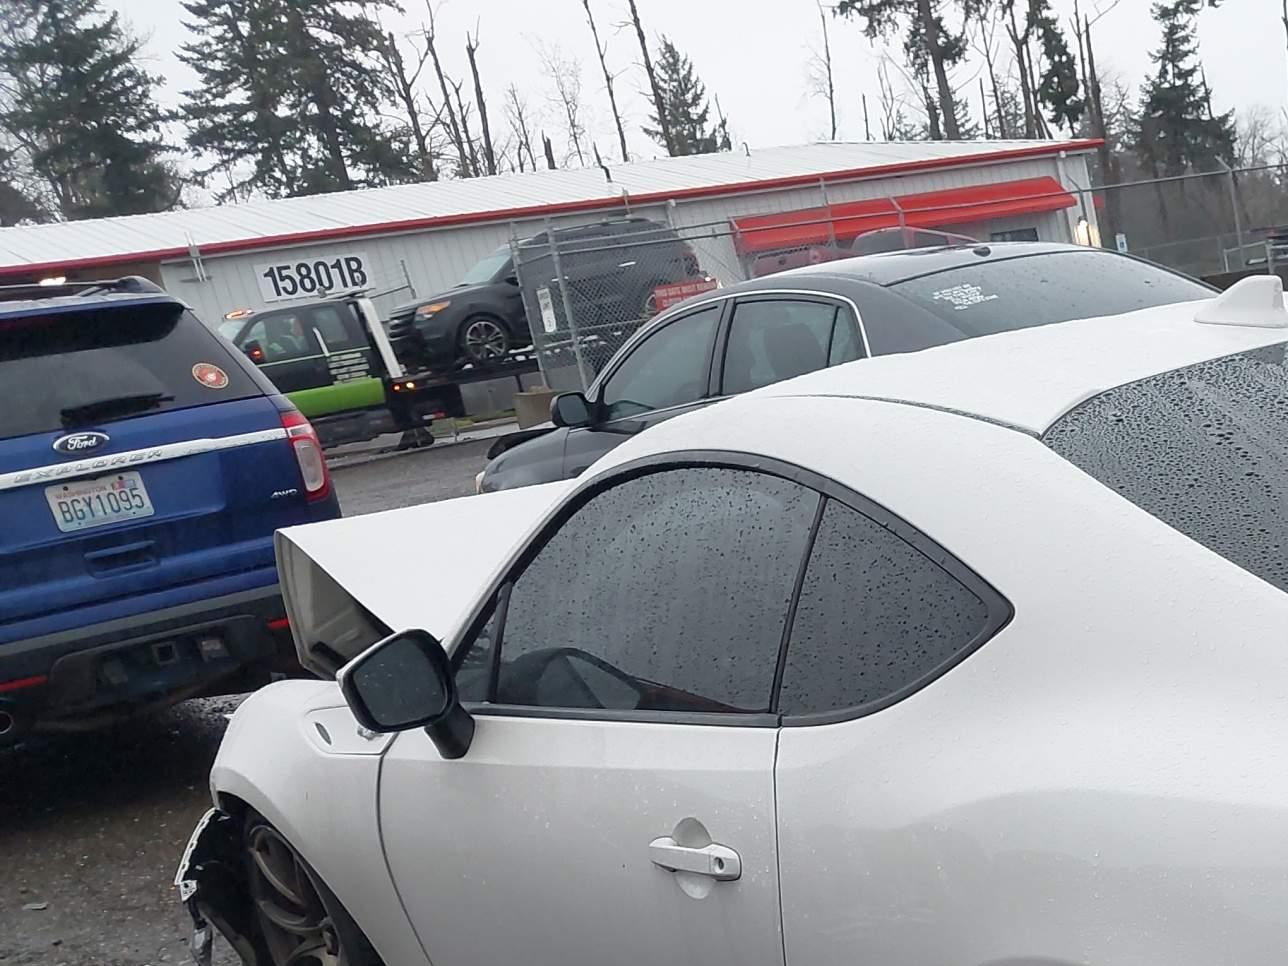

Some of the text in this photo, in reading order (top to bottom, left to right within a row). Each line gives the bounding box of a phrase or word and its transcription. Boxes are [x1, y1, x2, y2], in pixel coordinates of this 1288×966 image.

[263, 256, 367, 297] 15801B
[67, 435, 97, 450] Ford
[14, 450, 163, 484] EXPLORER
[57, 487, 145, 524] BGY1095
